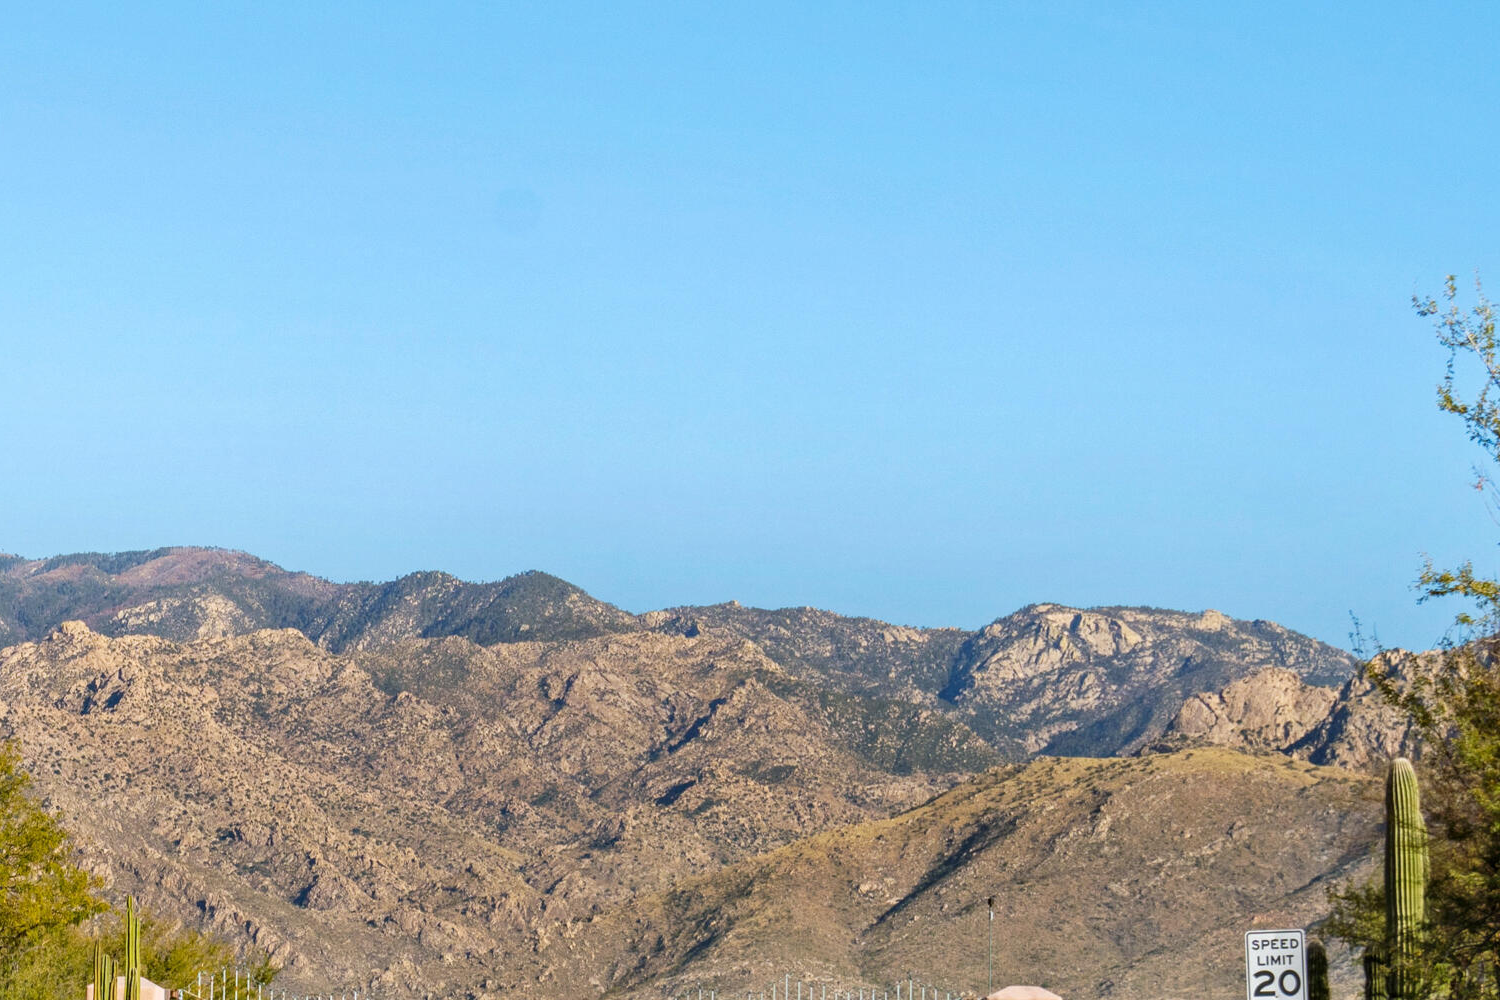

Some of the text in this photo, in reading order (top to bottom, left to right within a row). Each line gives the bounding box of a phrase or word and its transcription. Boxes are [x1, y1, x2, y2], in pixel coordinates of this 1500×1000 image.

[1252, 938, 1299, 951] SPEED
[1257, 954, 1294, 966] LIMIT
[1253, 969, 1301, 997] 20
